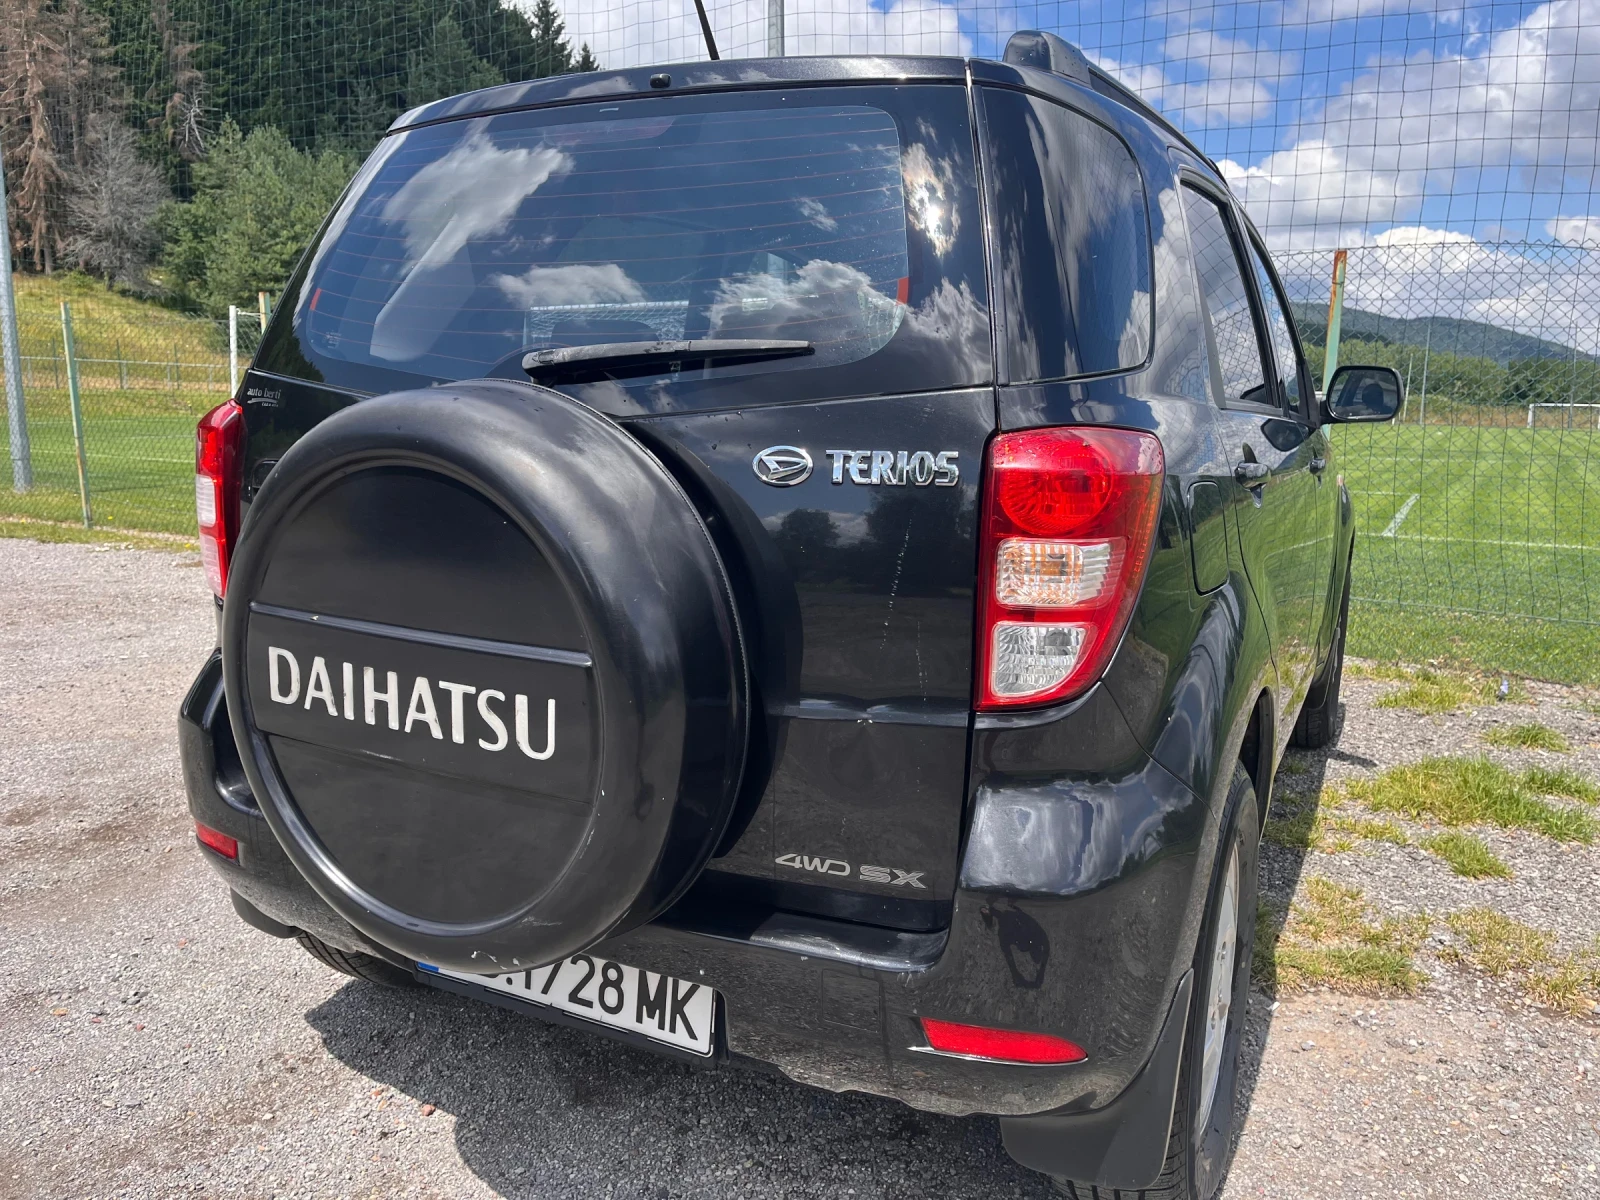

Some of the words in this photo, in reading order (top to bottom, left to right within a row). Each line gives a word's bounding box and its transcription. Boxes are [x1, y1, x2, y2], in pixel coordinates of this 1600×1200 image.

[247, 388, 262, 397] auto
[264, 388, 281, 399] berti
[826, 450, 960, 486] TERIOS
[269, 646, 556, 760] DAIHATSU
[775, 853, 851, 876] 4WD
[859, 865, 927, 889] SX
